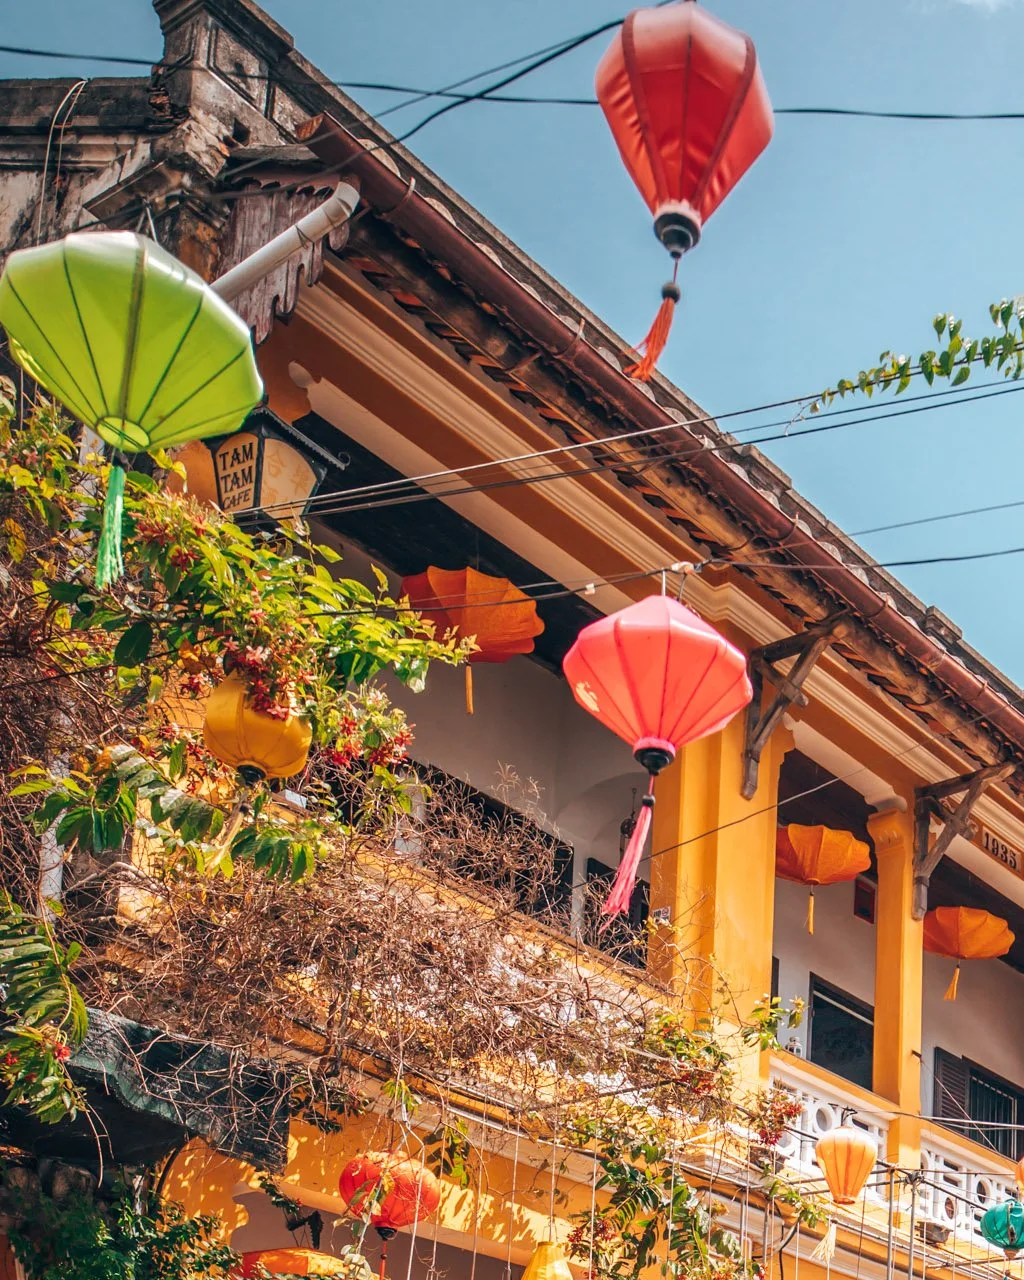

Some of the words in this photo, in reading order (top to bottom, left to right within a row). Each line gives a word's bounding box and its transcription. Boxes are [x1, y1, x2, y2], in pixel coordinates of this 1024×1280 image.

[219, 442, 254, 471] TAM
[220, 465, 253, 494] TAM
[222, 488, 251, 510] CAFE
[983, 831, 1017, 870] 1935
